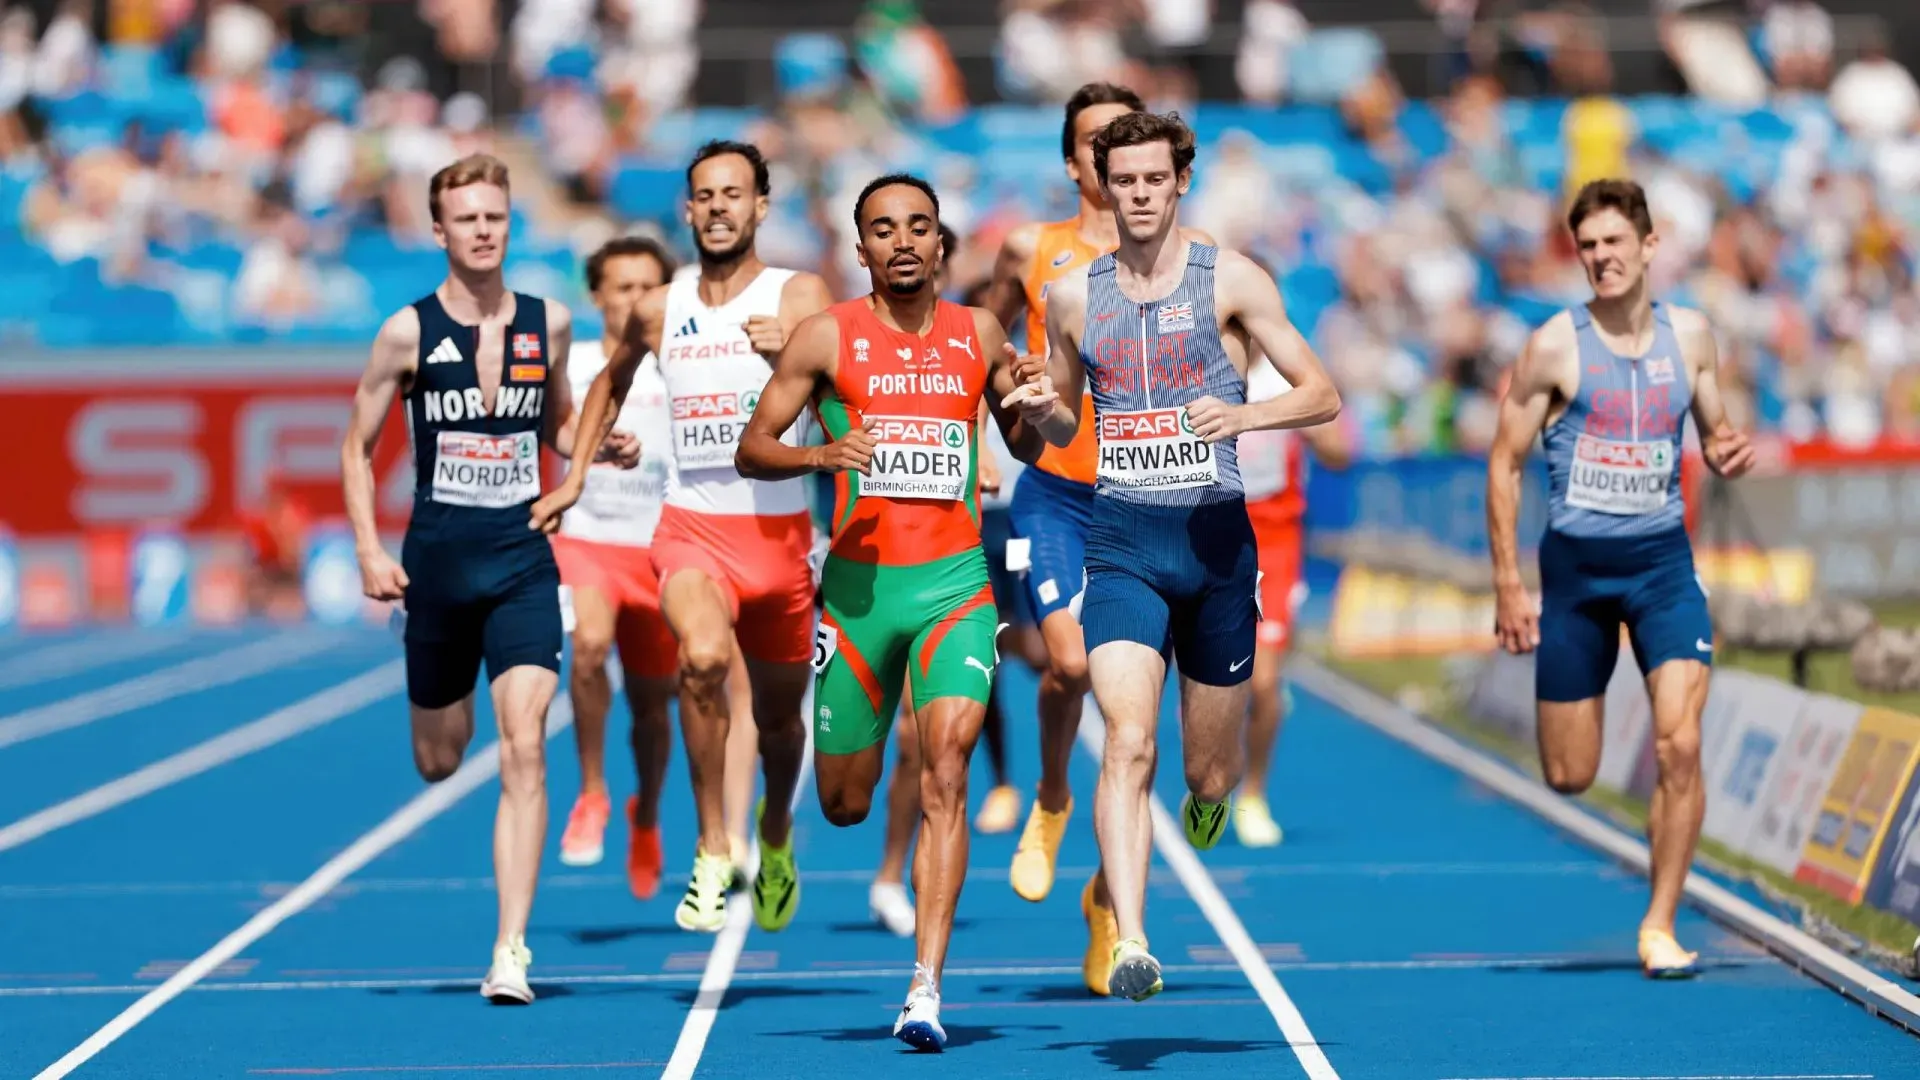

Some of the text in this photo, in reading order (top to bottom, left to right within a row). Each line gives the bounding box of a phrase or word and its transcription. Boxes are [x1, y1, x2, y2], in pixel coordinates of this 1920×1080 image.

[668, 341, 754, 361] FRANC
[1096, 333, 1189, 366] GREAT
[868, 373, 968, 397] PORTUGAL
[1096, 361, 1205, 393] BRITAIN
[673, 395, 736, 419] SPAR
[868, 421, 941, 443] SPAR
[1103, 413, 1177, 437] SPAR
[442, 436, 514, 460] SPAR
[1101, 440, 1210, 471] HEYWARD
[1578, 438, 1648, 467] SPAR
[439, 459, 535, 487] NORDÅS
[869, 450, 962, 478] NADER
[863, 481, 938, 493] BIRMINGHAM
[1183, 471, 1213, 482] 2026
